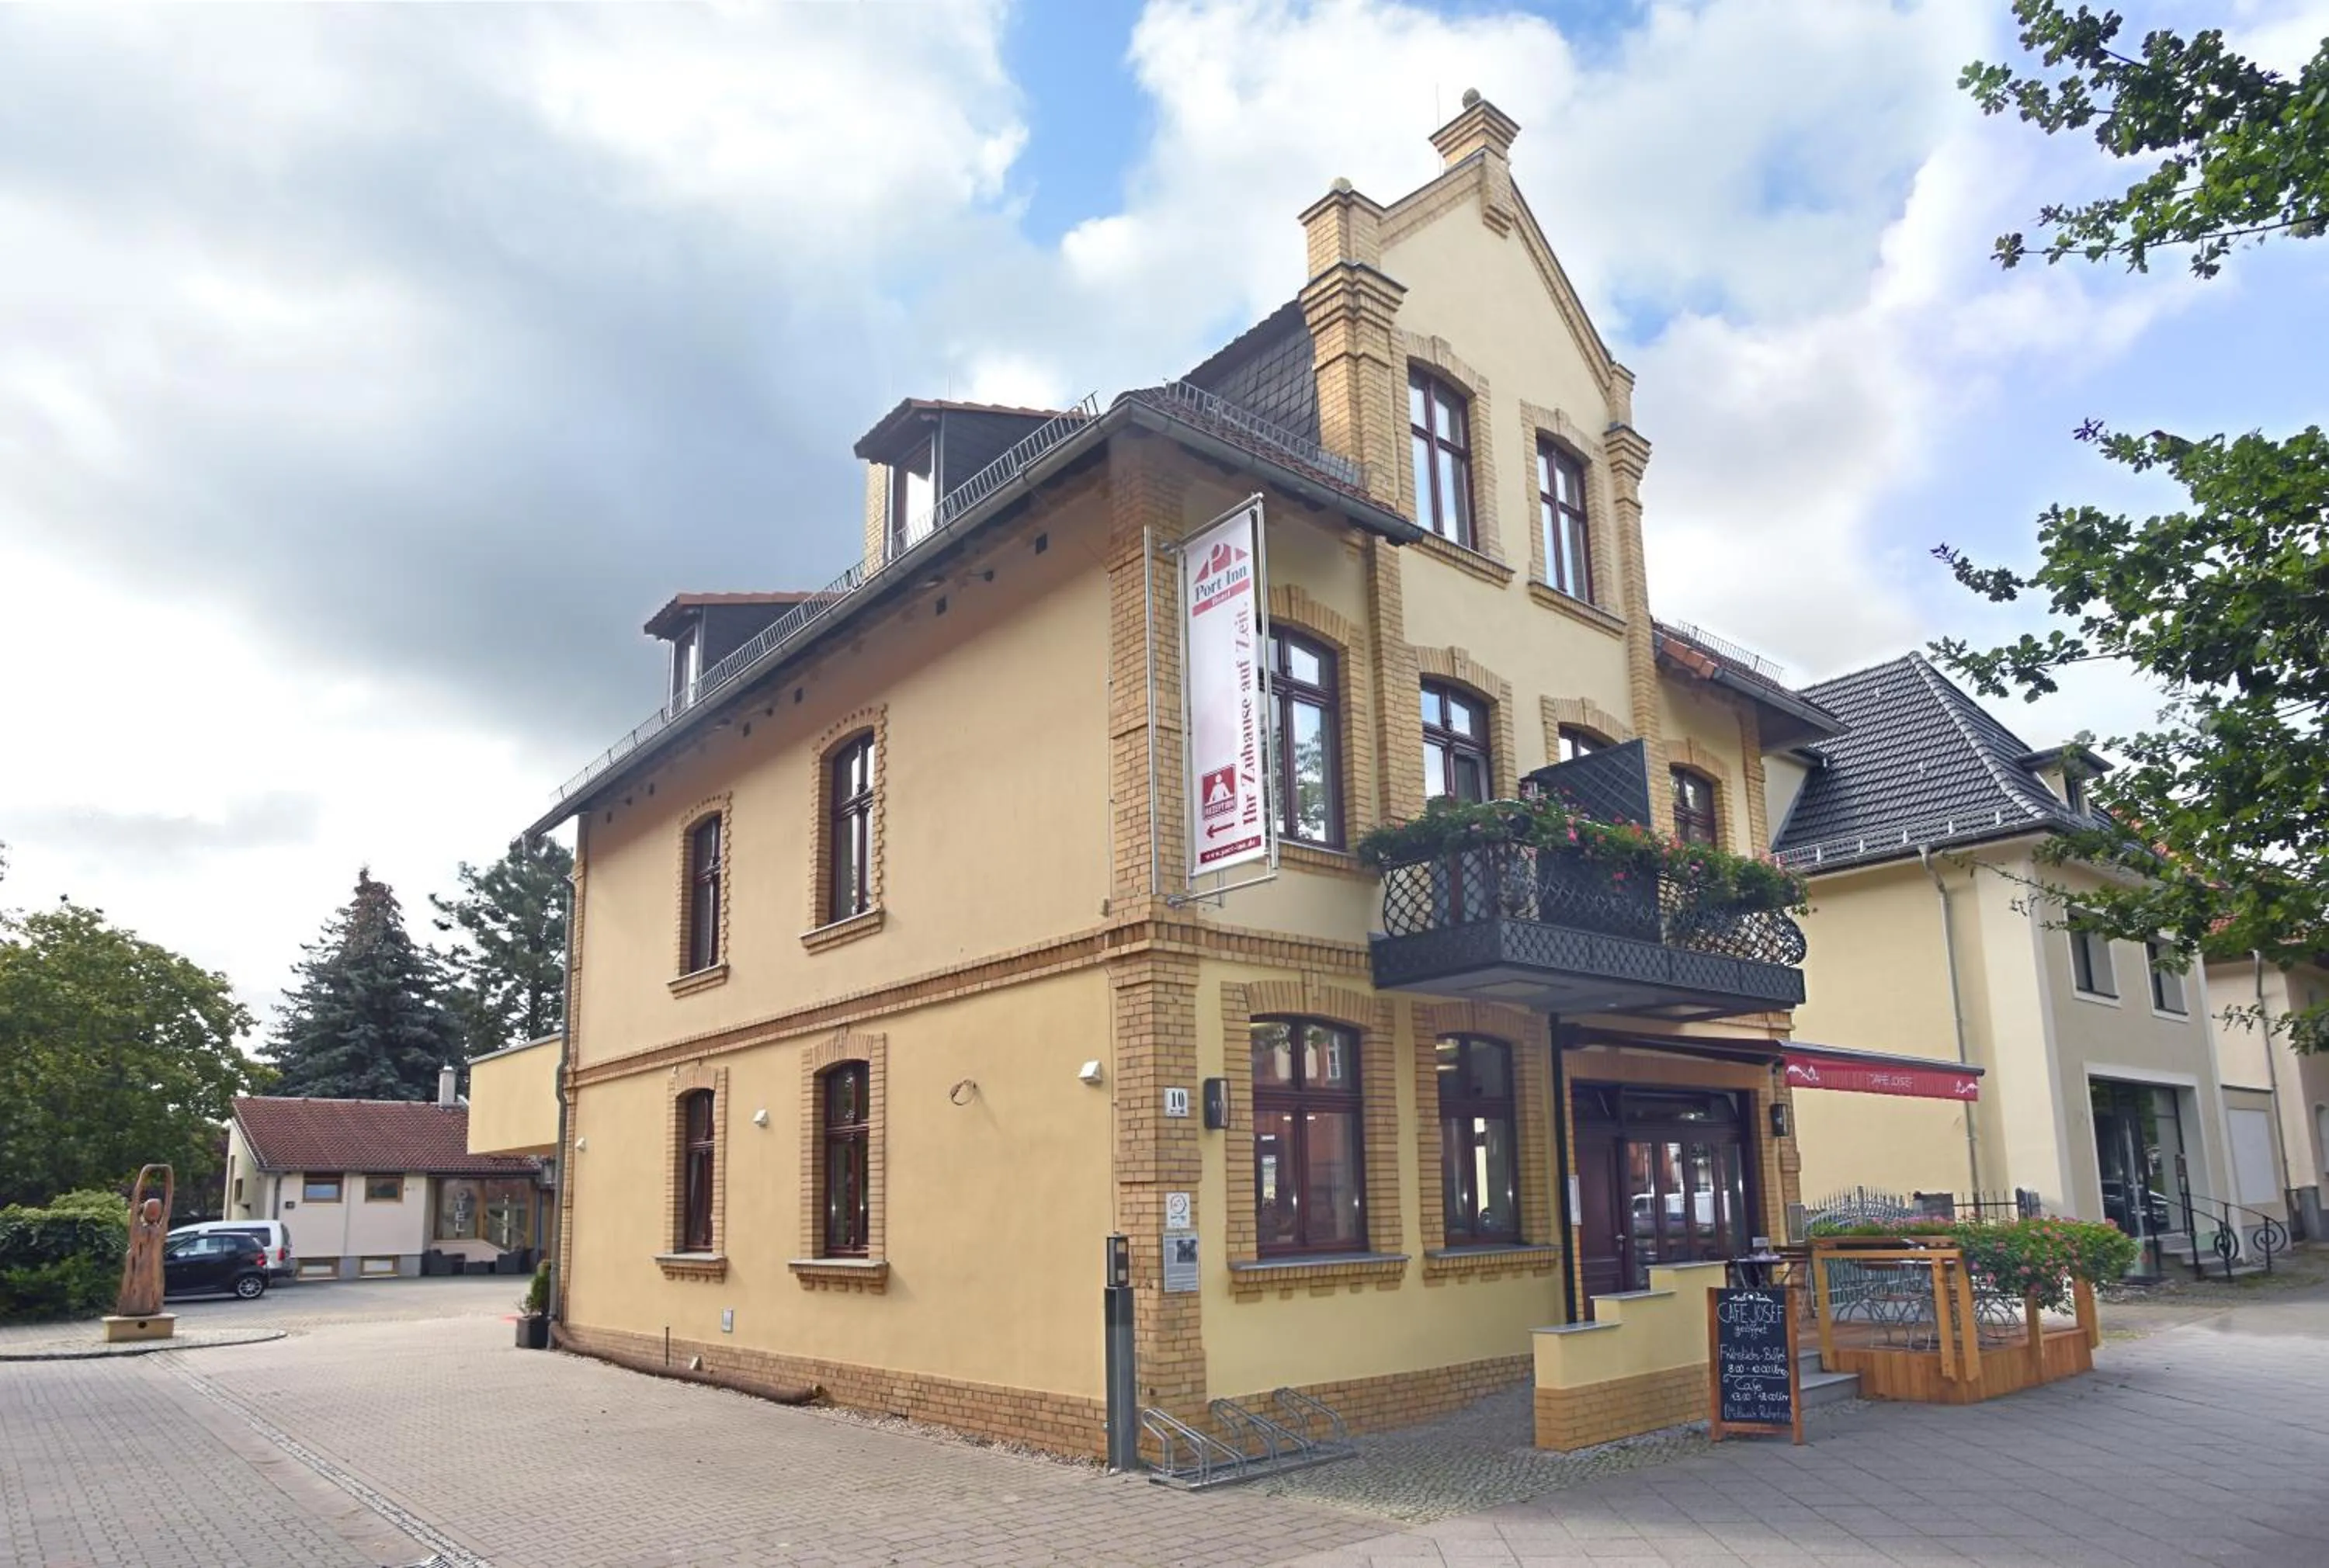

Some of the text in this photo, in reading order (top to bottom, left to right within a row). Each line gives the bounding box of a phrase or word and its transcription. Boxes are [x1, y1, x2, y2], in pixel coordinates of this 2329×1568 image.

[1196, 565, 1248, 602] Port Inn
[1236, 659, 1251, 692] auf
[1240, 698, 1256, 786] Zuhause
[1242, 793, 1257, 825] Ihr
[1171, 1091, 1185, 1108] 10
[455, 1187, 467, 1232] OTEL
